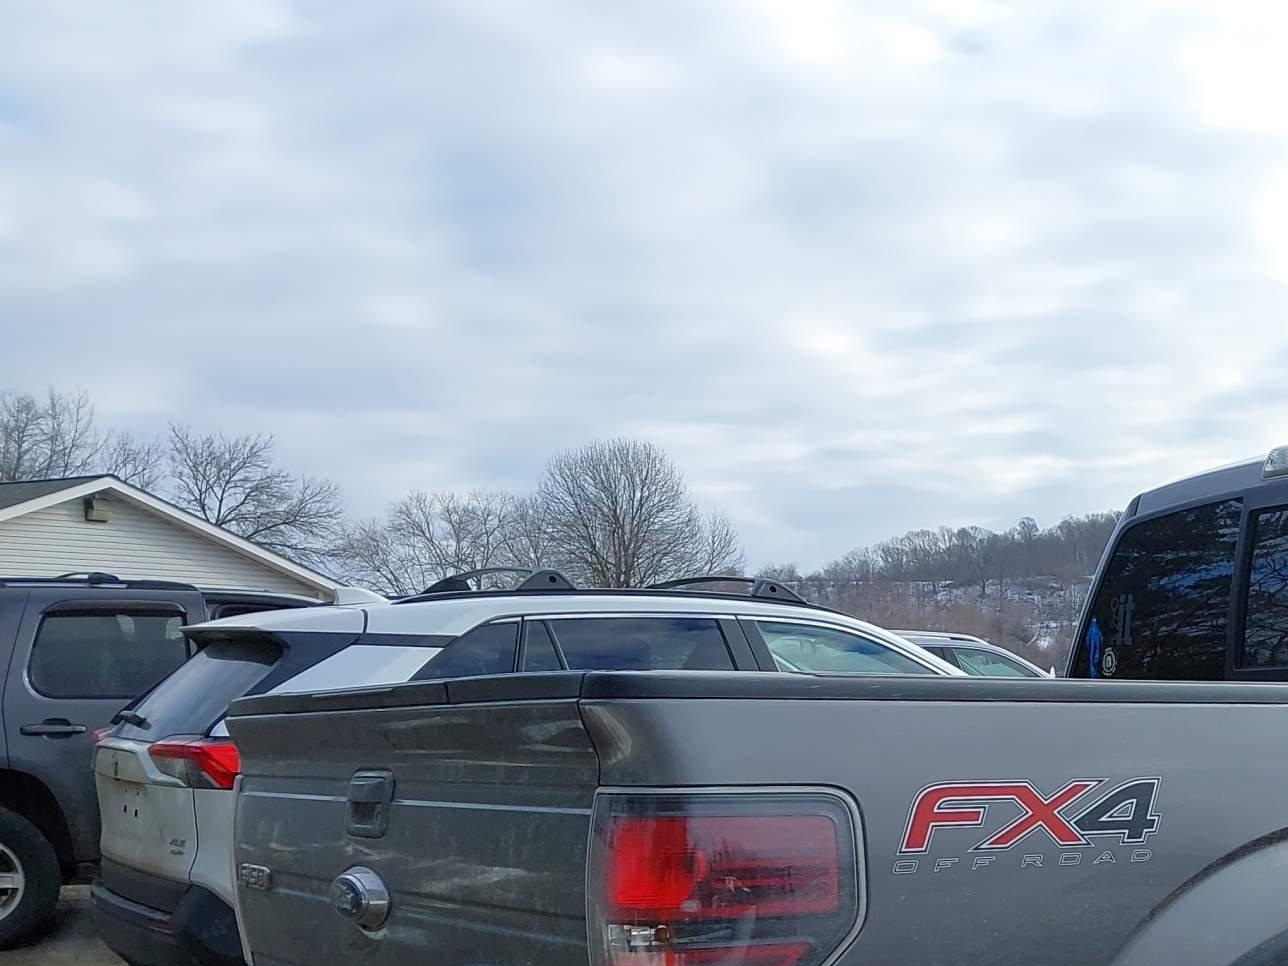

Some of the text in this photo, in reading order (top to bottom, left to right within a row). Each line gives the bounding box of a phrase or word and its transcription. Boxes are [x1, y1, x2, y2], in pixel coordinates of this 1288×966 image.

[896, 776, 1162, 856] FX4
[892, 849, 1153, 874] OFF ROAD
